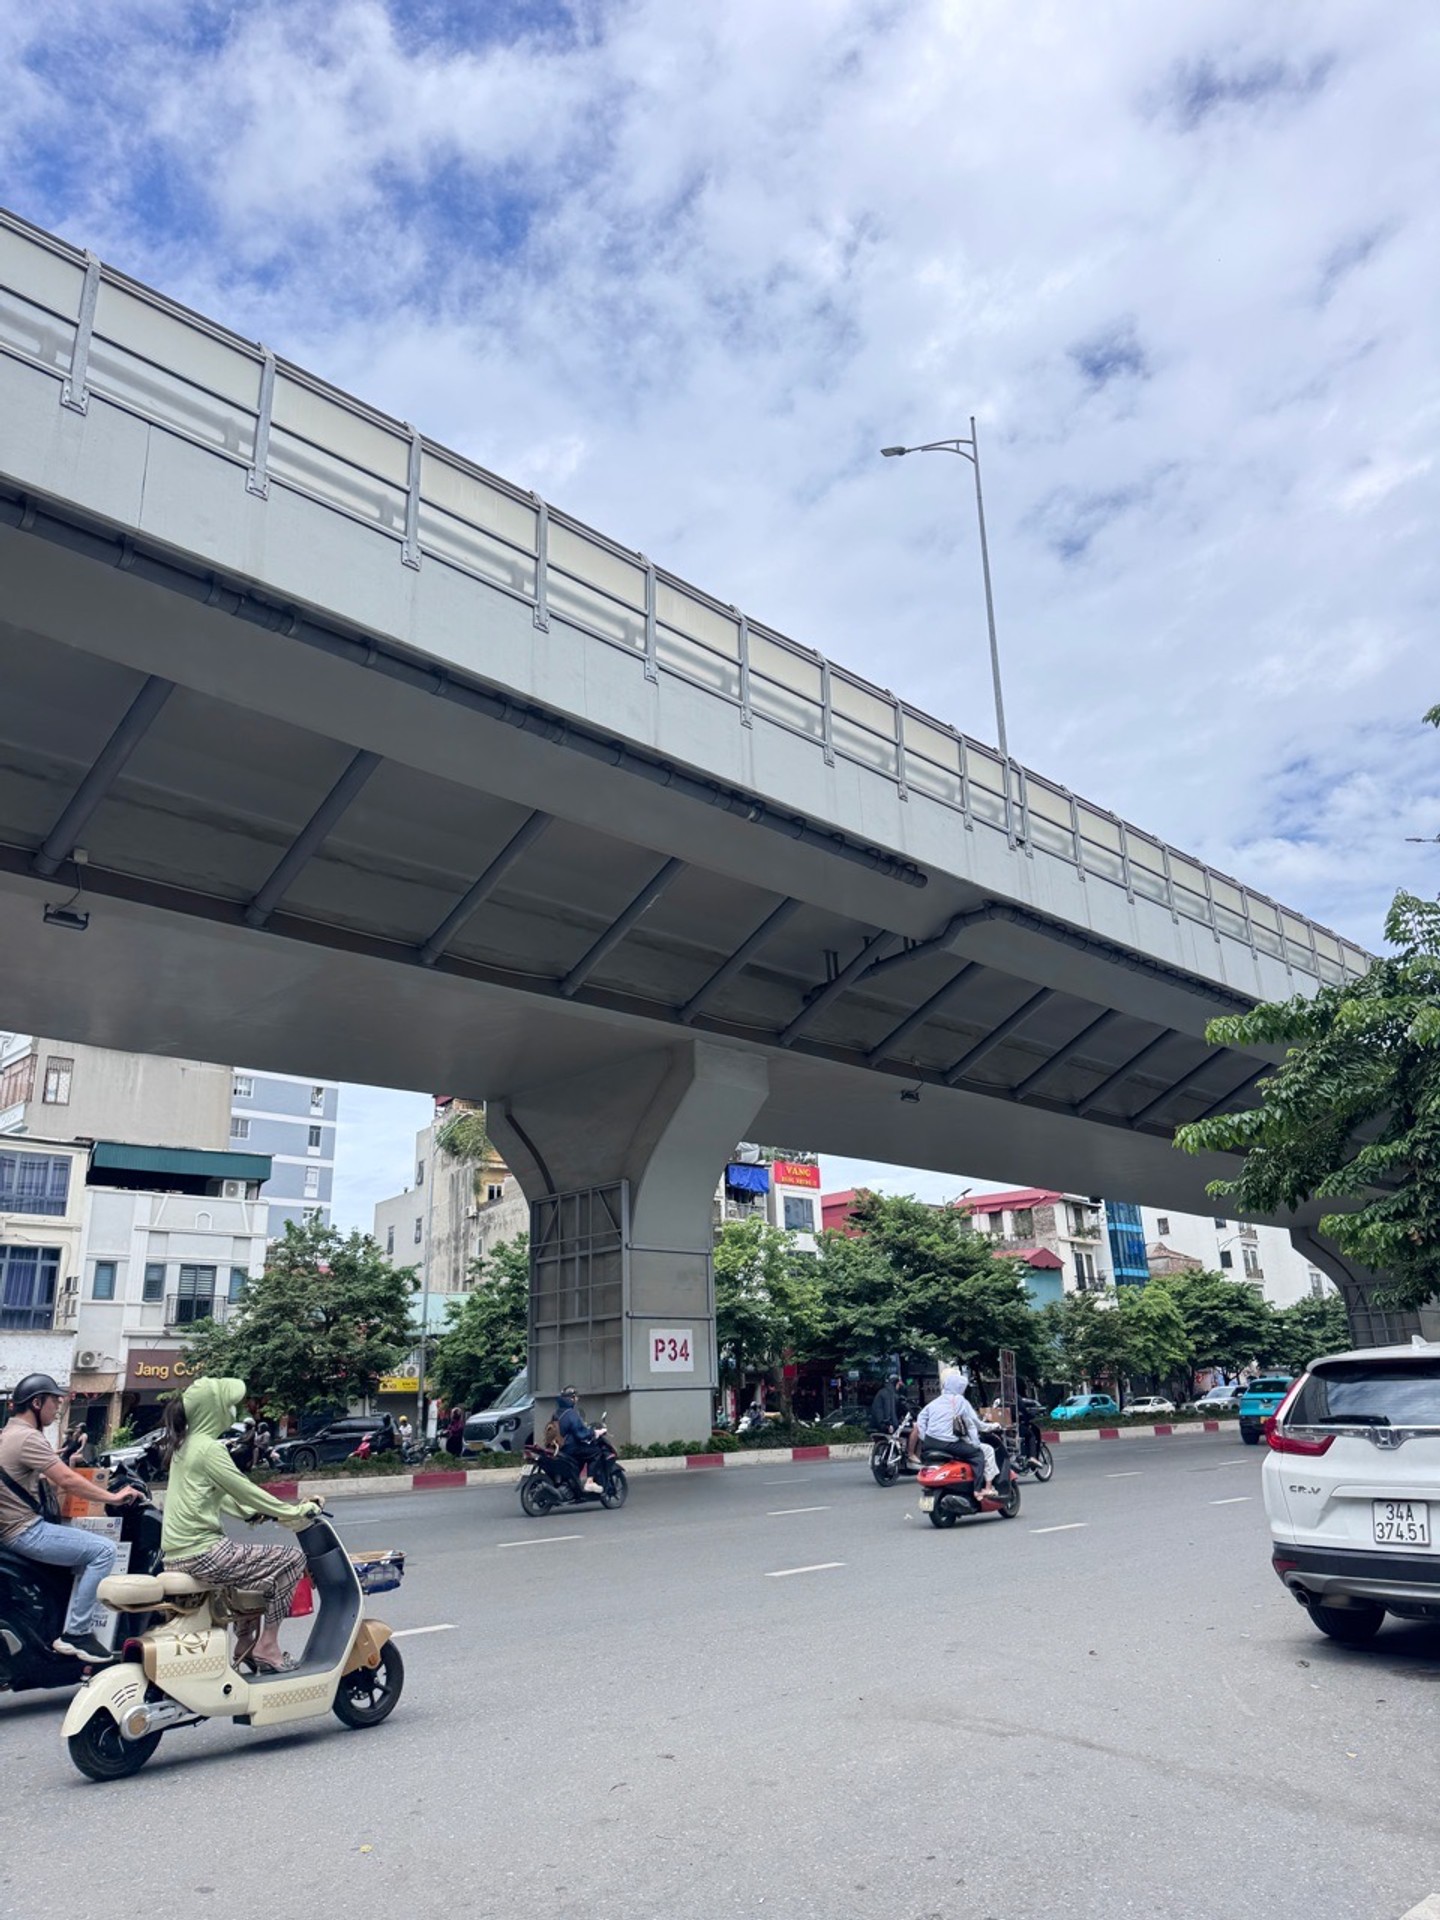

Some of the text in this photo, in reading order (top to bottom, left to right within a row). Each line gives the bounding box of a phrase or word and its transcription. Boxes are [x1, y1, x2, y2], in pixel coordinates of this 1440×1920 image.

[655, 1338, 690, 1361] P34
[134, 1361, 169, 1380] Jang
[1386, 1503, 1415, 1522] 34A
[1376, 1522, 1426, 1541] 374.51
